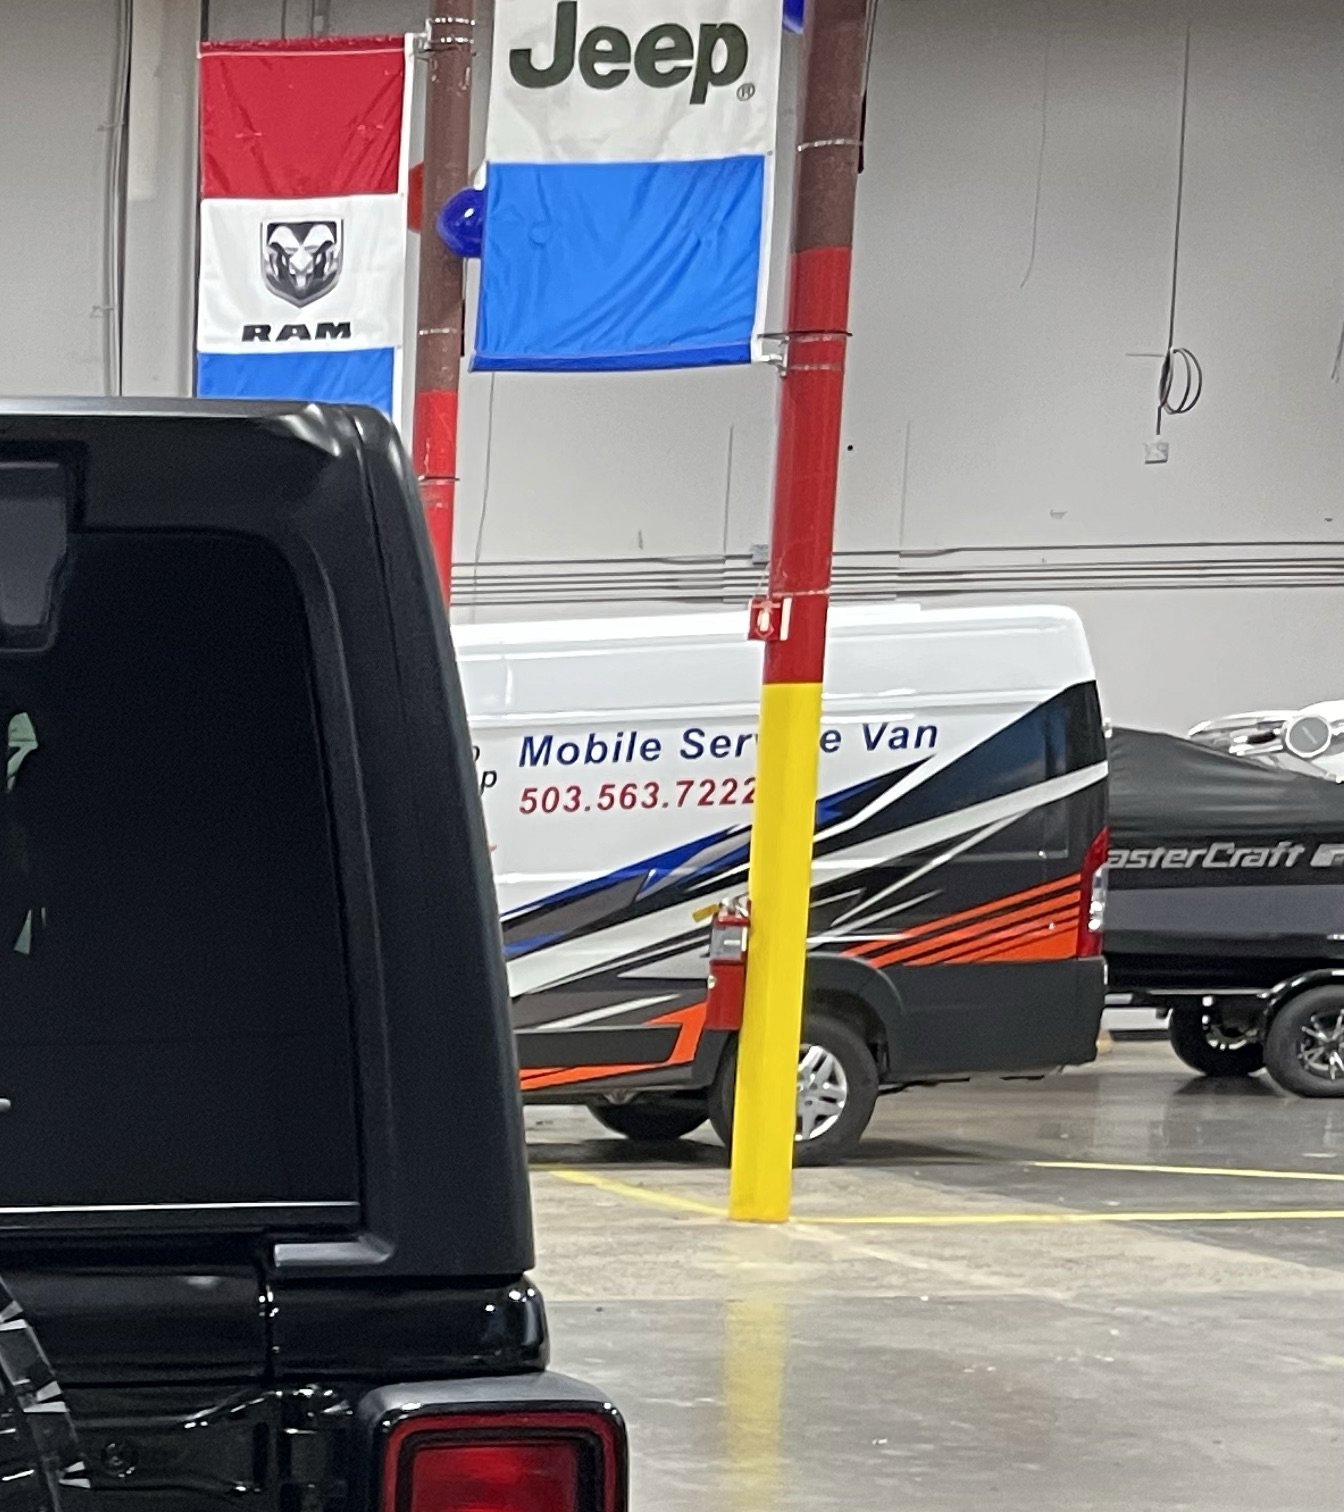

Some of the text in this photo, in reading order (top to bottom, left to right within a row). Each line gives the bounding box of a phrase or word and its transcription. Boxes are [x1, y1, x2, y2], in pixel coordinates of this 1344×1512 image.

[508, 1, 749, 105] Jeep
[241, 320, 352, 342] RAM
[518, 731, 662, 768] Mobile
[679, 727, 842, 760] Sere
[862, 723, 939, 751] Van
[518, 777, 756, 815] 503.563.7222
[1108, 842, 1306, 869] asterCraft
